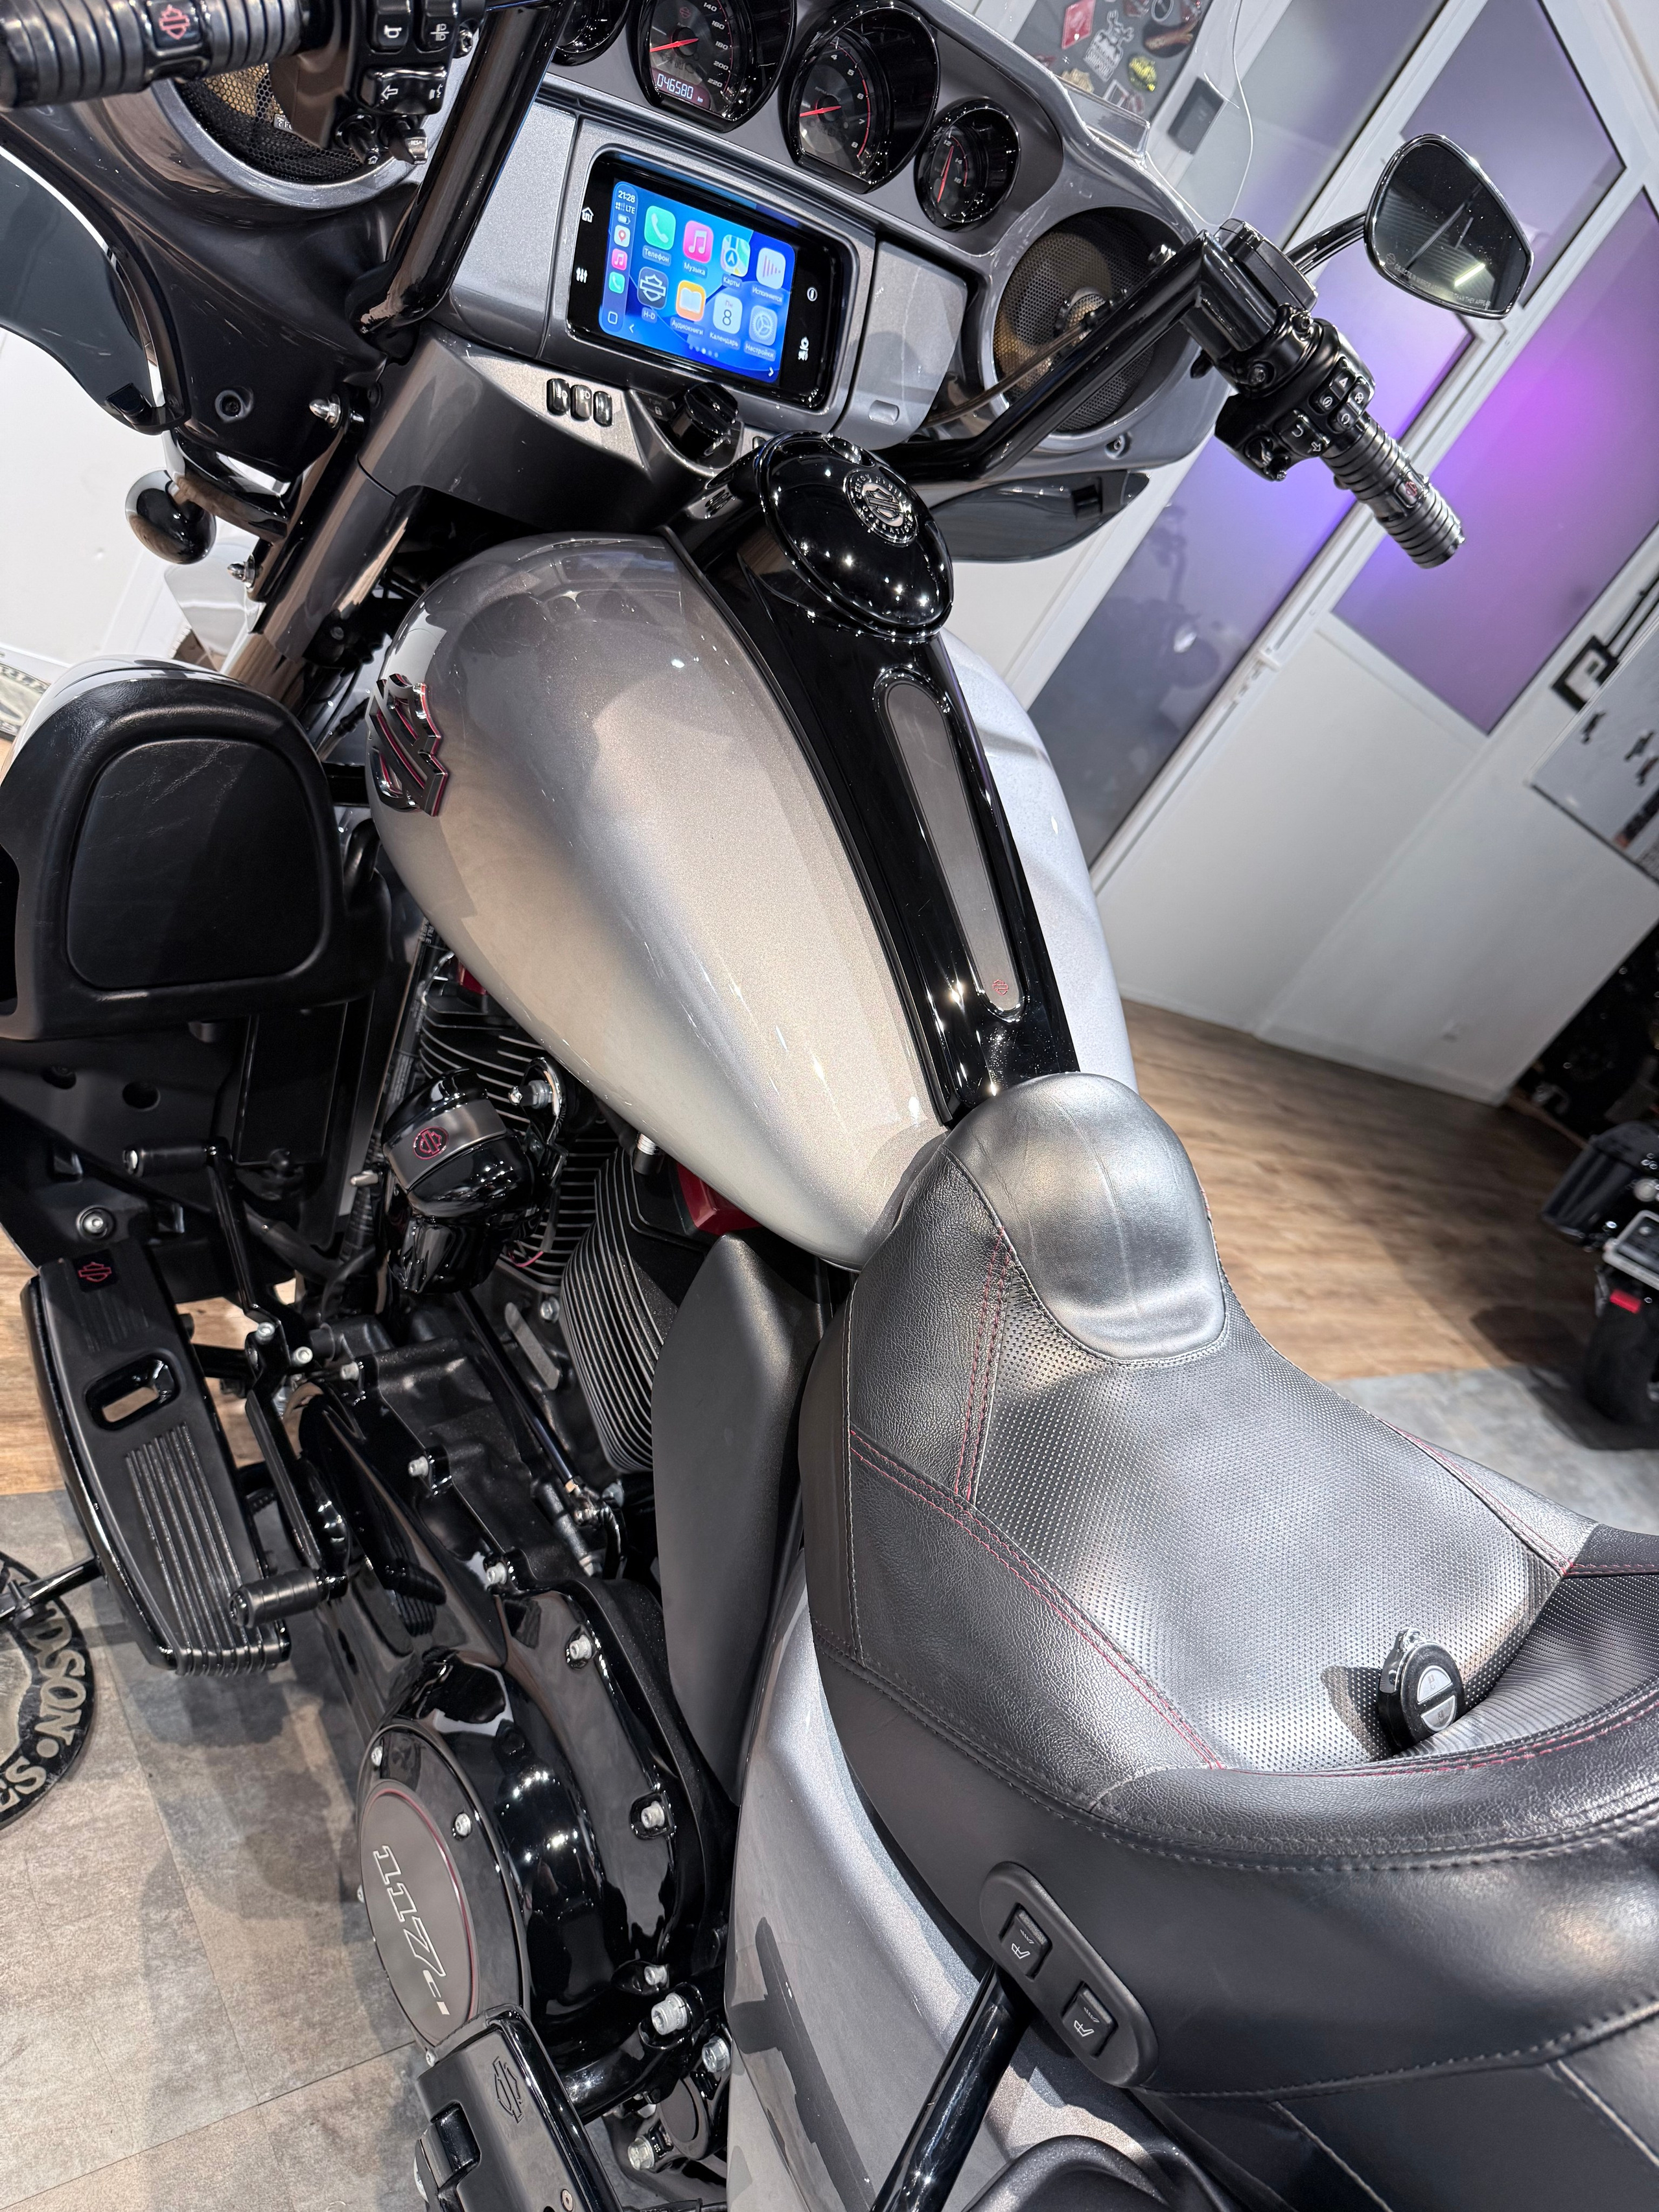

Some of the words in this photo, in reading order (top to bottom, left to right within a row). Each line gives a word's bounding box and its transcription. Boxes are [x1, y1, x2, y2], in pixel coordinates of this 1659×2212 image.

[703, 2, 717, 12] 140
[712, 20, 725, 30] 160
[715, 41, 728, 51] 180
[713, 60, 729, 71] 200
[656, 73, 694, 99] 046580
[707, 78, 723, 87] 220
[618, 190, 636, 204] 21:28
[625, 204, 636, 215] LTE
[644, 248, 669, 263] Телефон
[684, 262, 706, 276] Музыка
[723, 277, 741, 288] Карты
[644, 310, 656, 320] H-D
[722, 309, 732, 326] 8
[671, 320, 704, 336] Аудиокниги
[710, 332, 739, 347] Календарь
[746, 343, 774, 358] Настройки
[373, 1845, 447, 1977] 117
